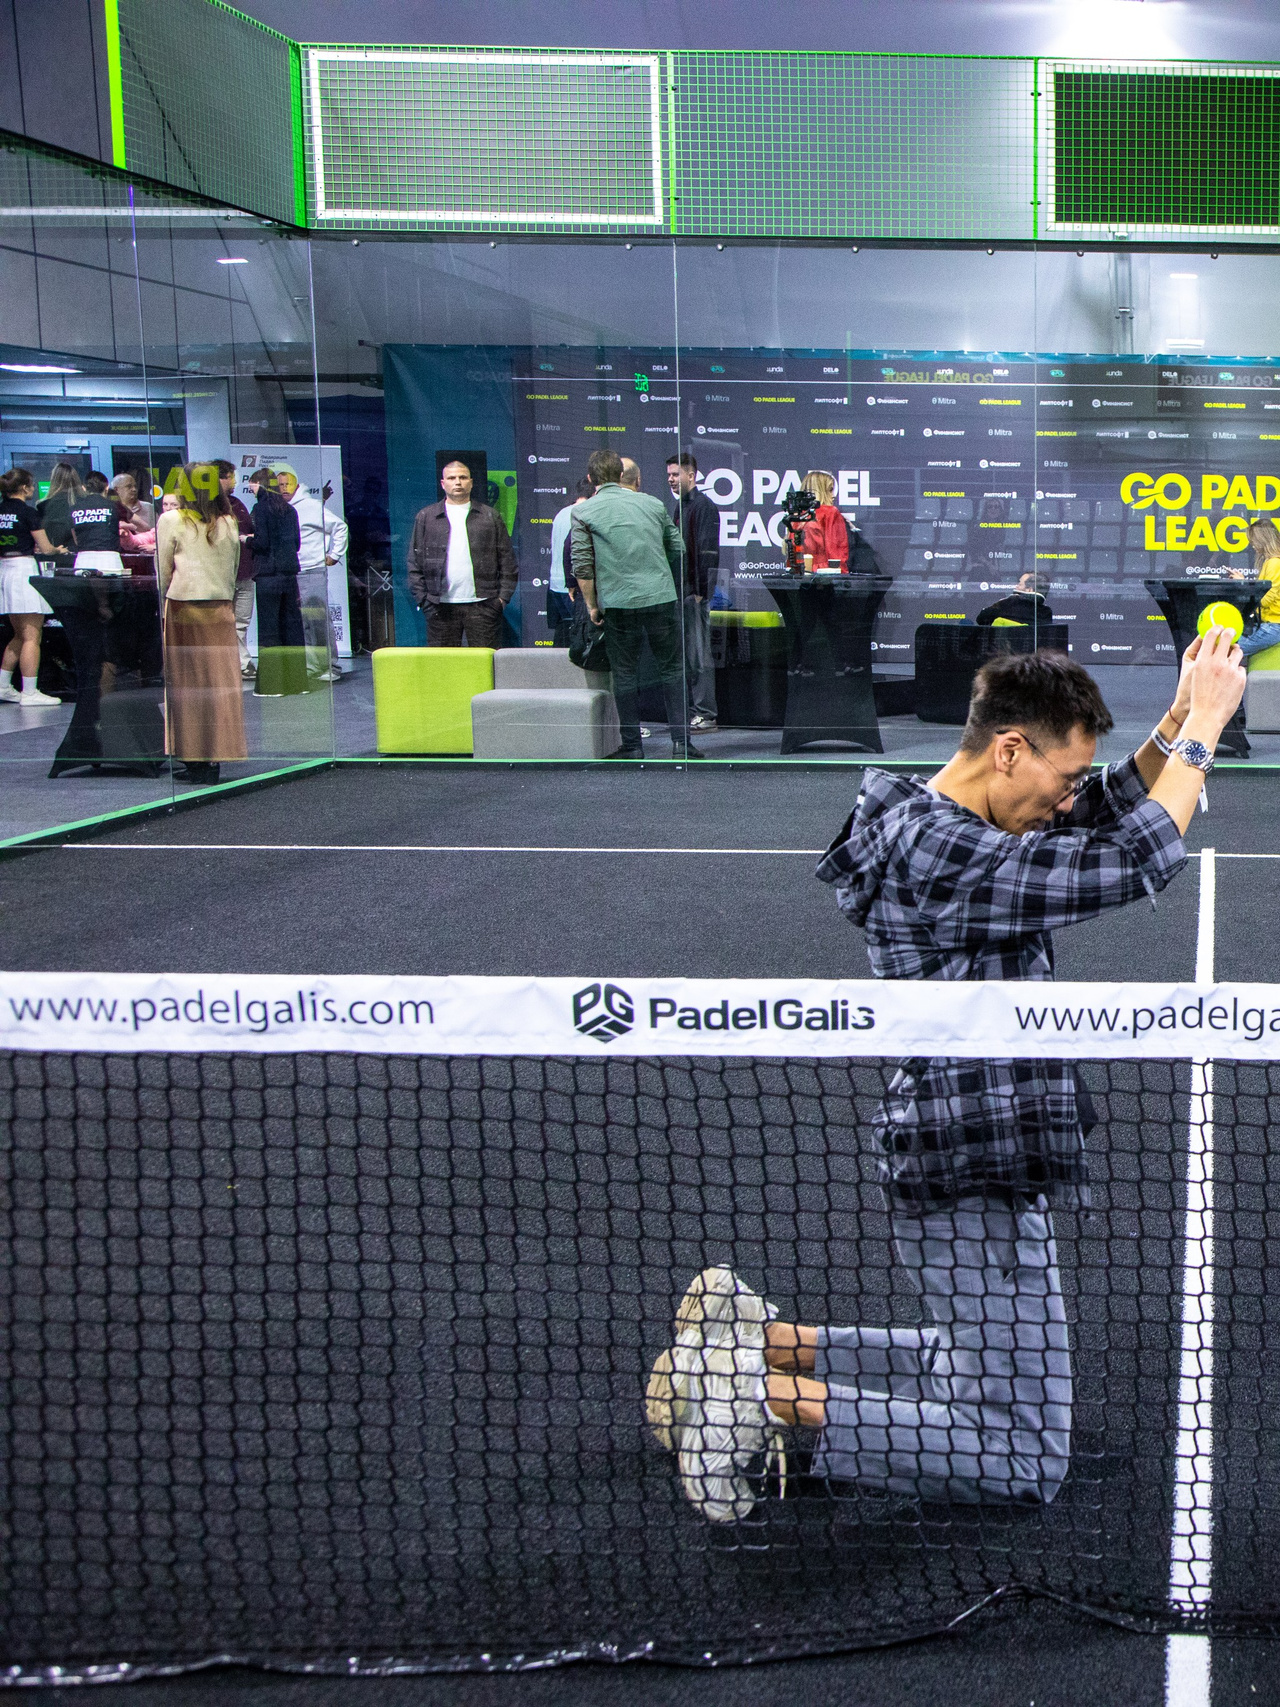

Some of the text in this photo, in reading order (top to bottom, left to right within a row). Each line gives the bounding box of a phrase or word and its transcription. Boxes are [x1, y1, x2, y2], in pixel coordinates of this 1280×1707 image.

[1120, 472, 1192, 510] GO
[72, 508, 112, 518] GO PADEL
[75, 515, 107, 525] LEAGUE
[738, 561, 787, 571] @GoPadelL
[1185, 566, 1259, 576] @GoPadeeague
[1106, 613, 1124, 621] Mitra
[9, 991, 435, 1033] www.padelgalis.com
[648, 997, 875, 1033] PadelGalis
